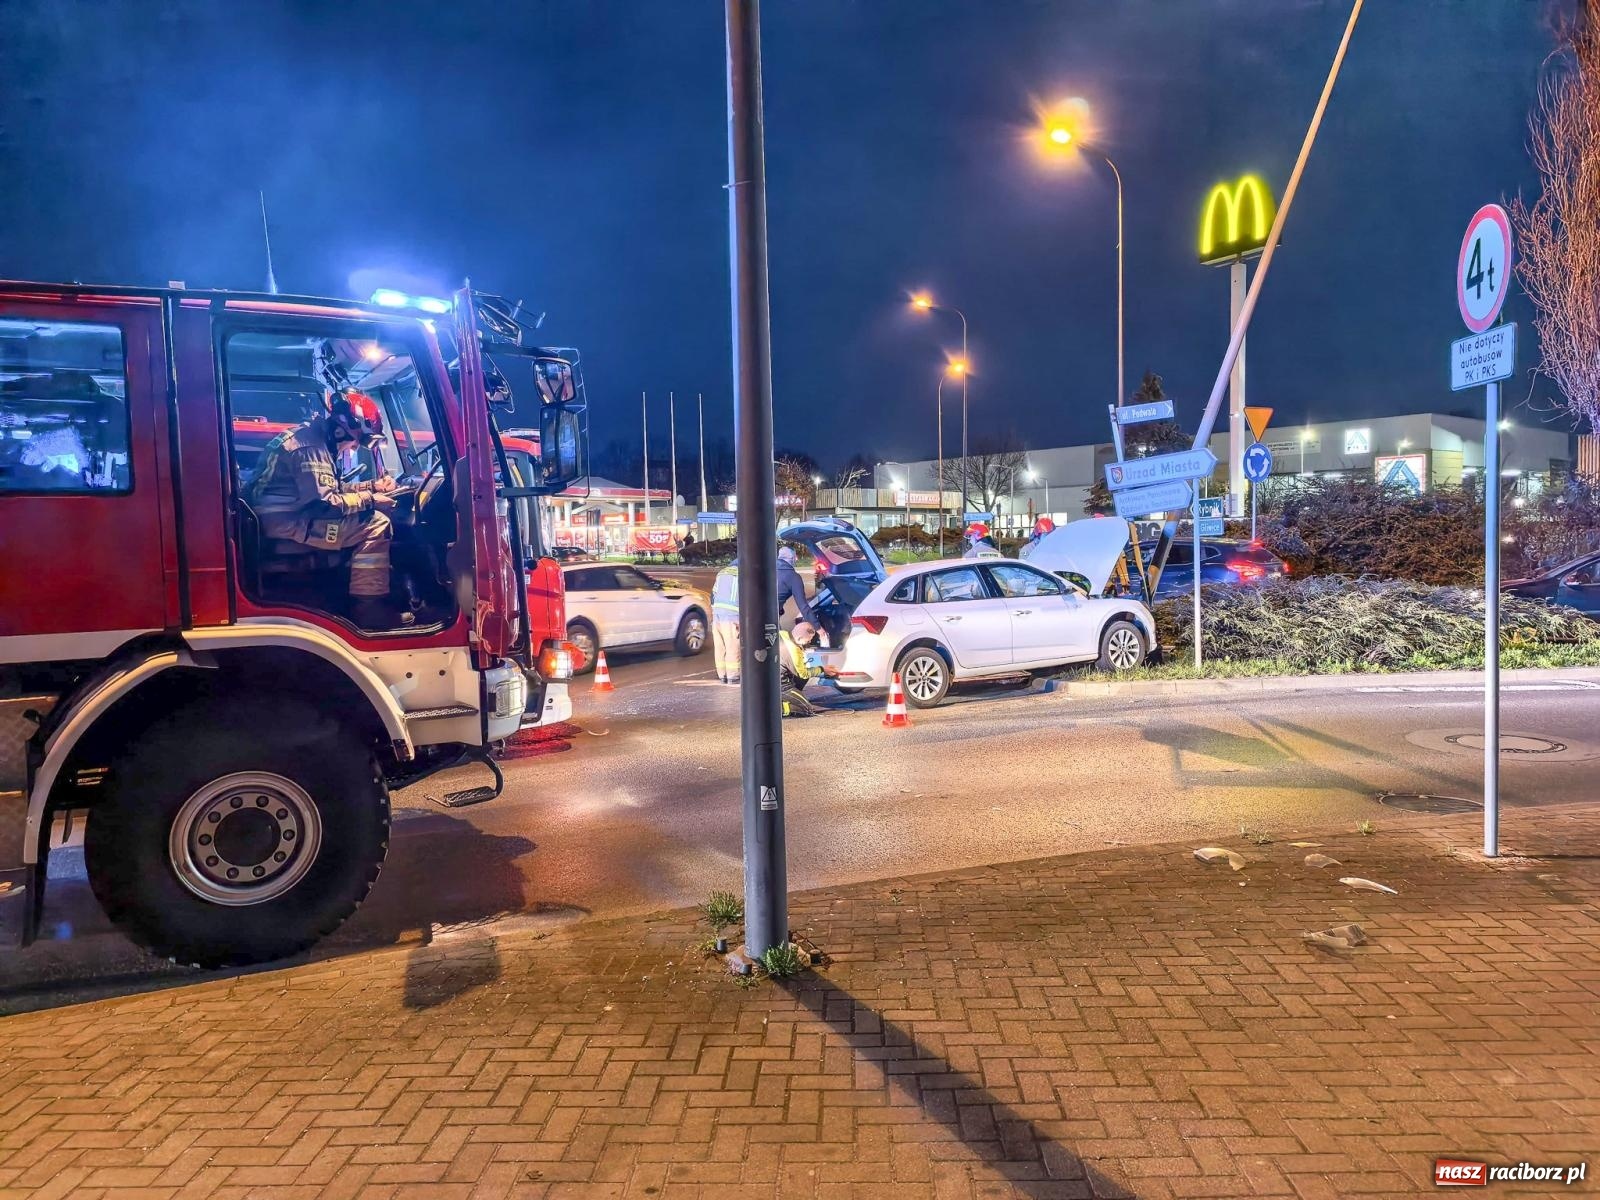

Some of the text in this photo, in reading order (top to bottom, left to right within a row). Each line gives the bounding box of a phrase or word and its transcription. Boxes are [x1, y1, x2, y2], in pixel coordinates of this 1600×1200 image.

[1466, 238, 1495, 300] 4 t
[1459, 332, 1504, 354] Nie dotyczy
[1464, 370, 1474, 383] PK
[1482, 363, 1496, 379] PKS
[1159, 458, 1201, 476] Miasta
